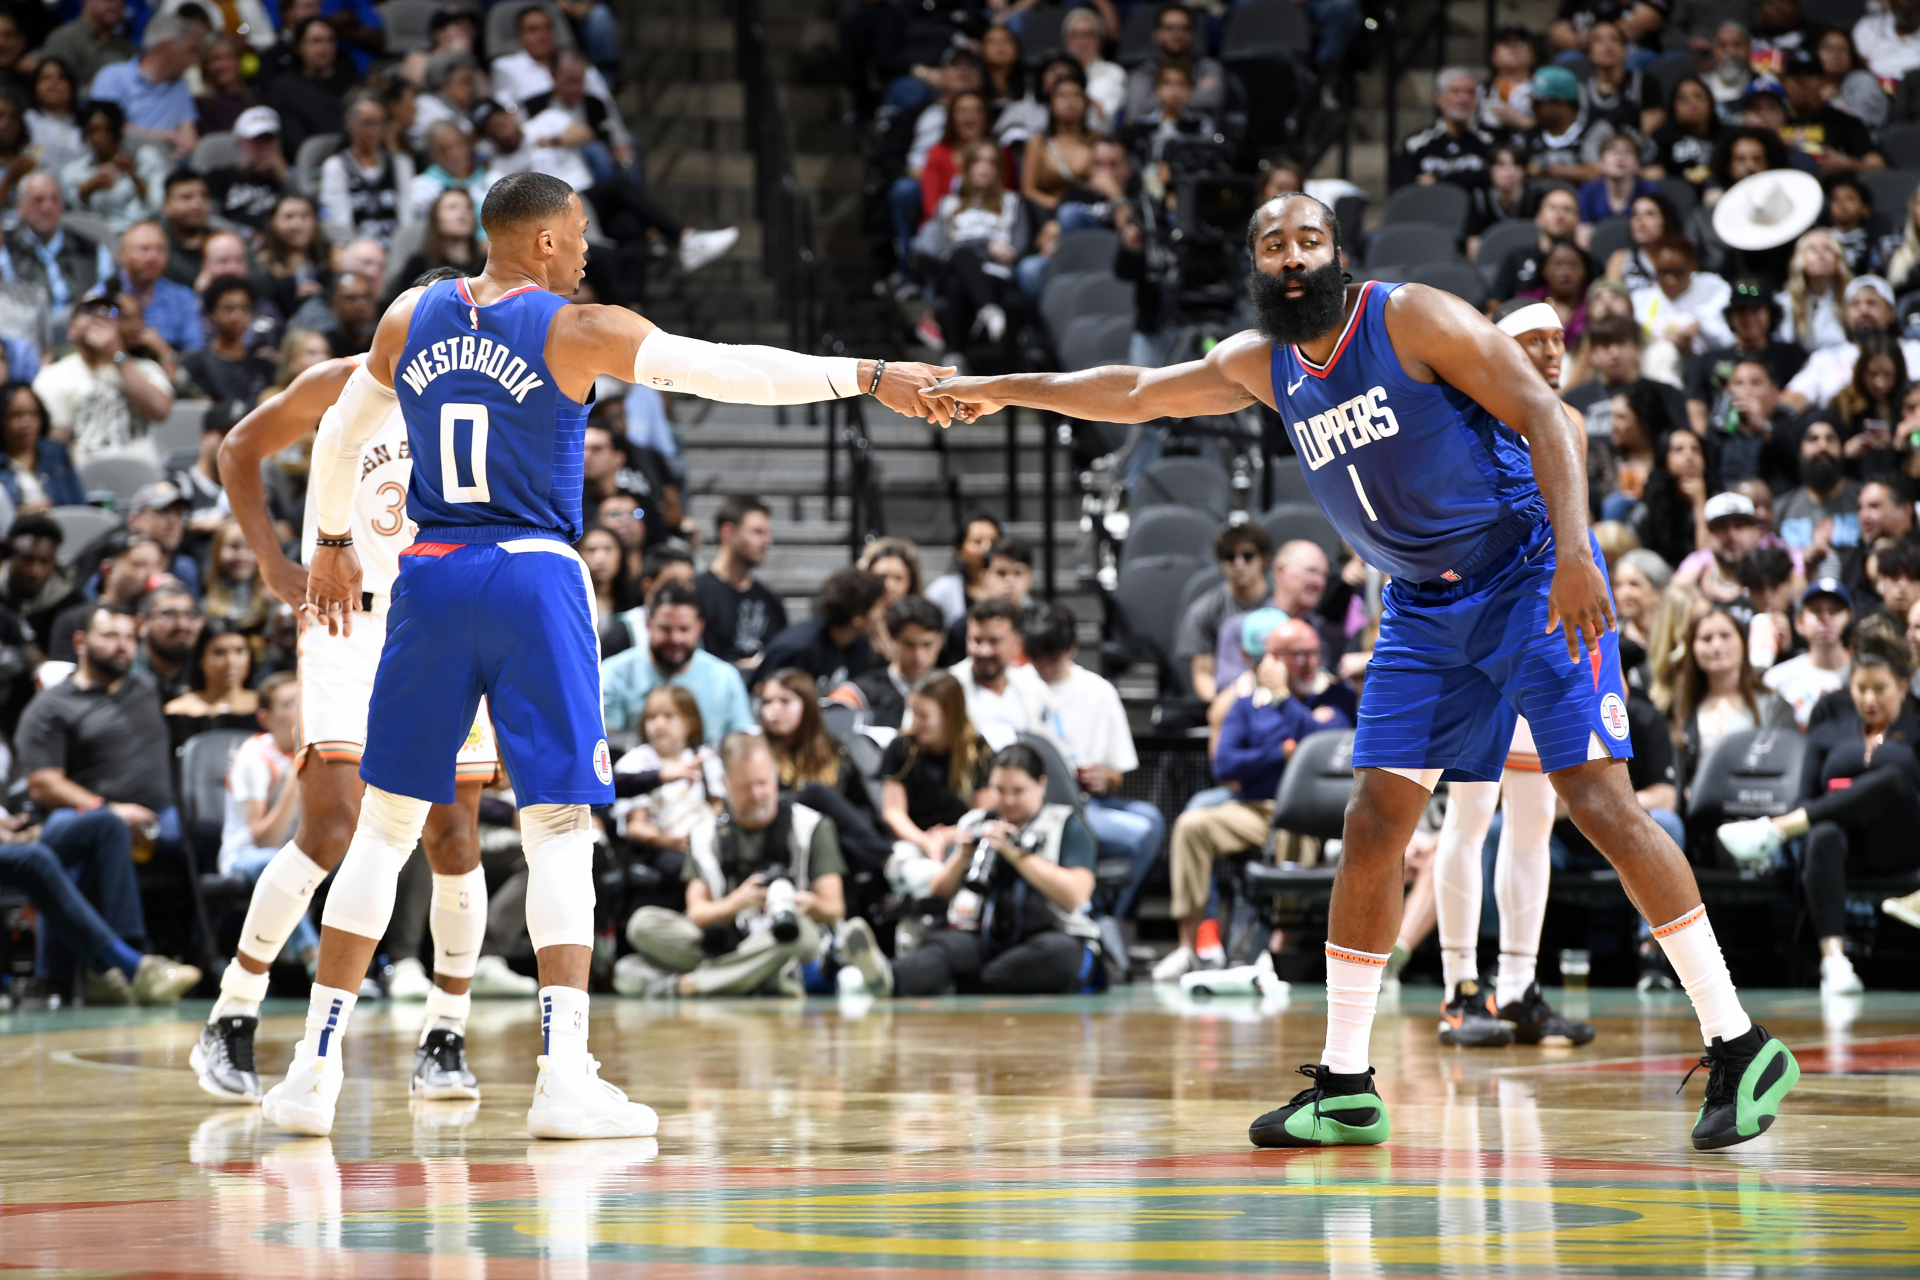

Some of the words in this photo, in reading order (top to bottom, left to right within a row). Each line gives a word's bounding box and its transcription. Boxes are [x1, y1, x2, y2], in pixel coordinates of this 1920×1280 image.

[401, 335, 545, 404] WESTBROOK
[440, 402, 491, 504] 0
[1293, 385, 1400, 471] CLIPPERS
[361, 443, 392, 483] AN
[1346, 463, 1378, 522] 1
[371, 481, 418, 539] 3
